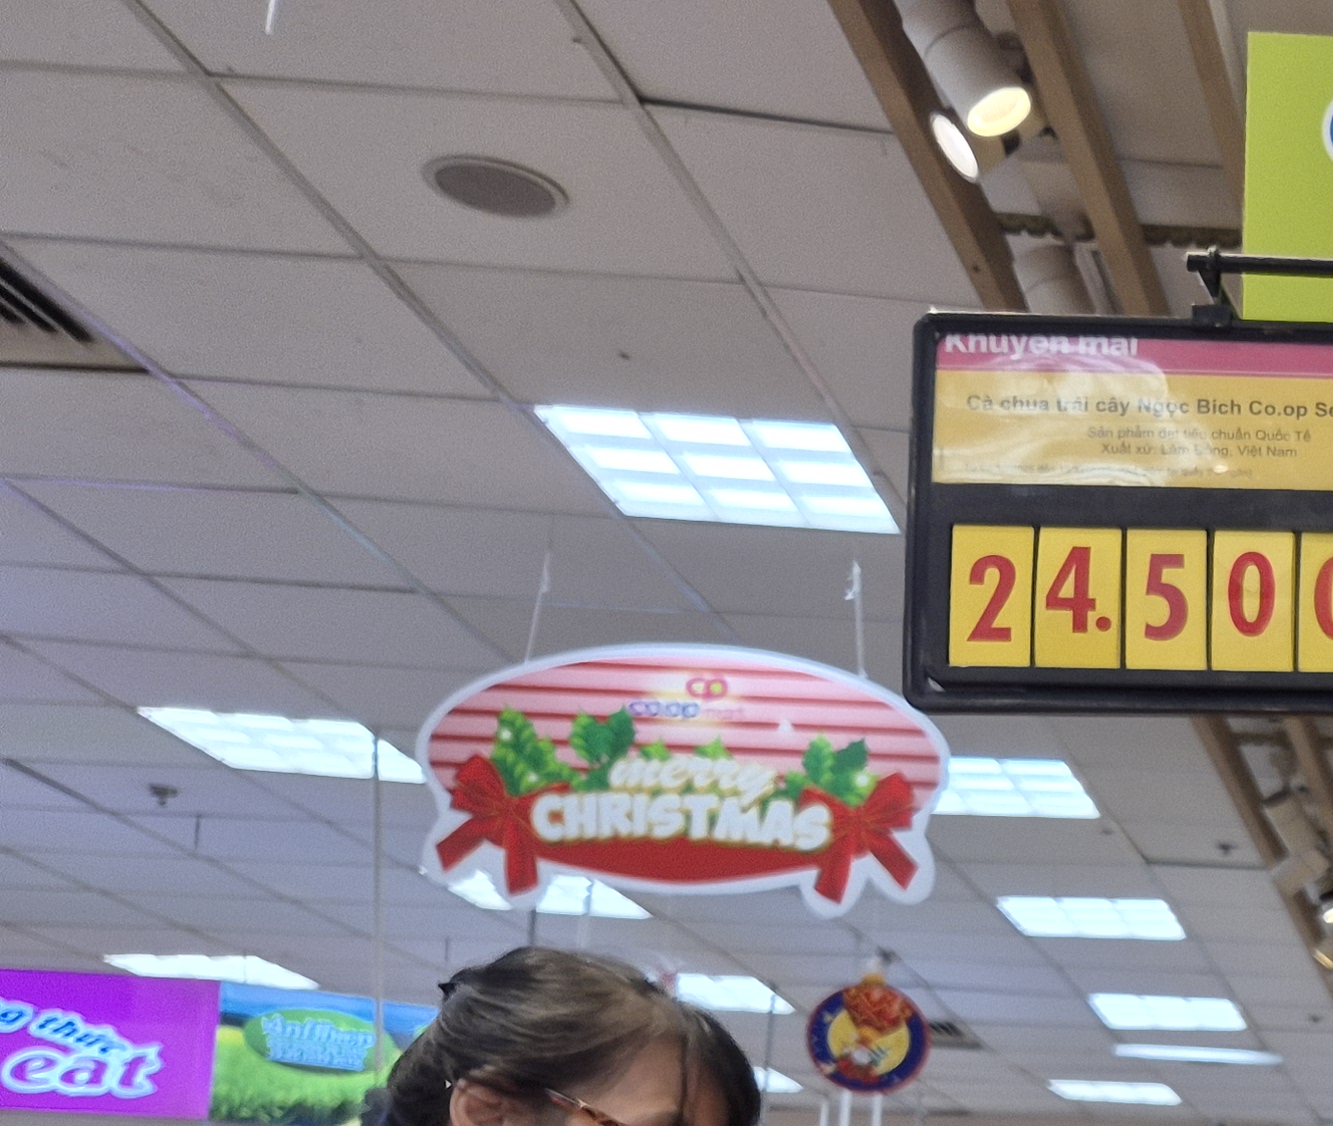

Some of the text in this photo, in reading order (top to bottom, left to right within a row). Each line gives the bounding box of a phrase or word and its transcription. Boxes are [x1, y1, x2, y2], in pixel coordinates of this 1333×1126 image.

[1000, 394, 1050, 412] chua
[1095, 396, 1131, 417] cây
[1248, 400, 1309, 420] Co.op
[531, 790, 834, 853] CHRISTMAS
